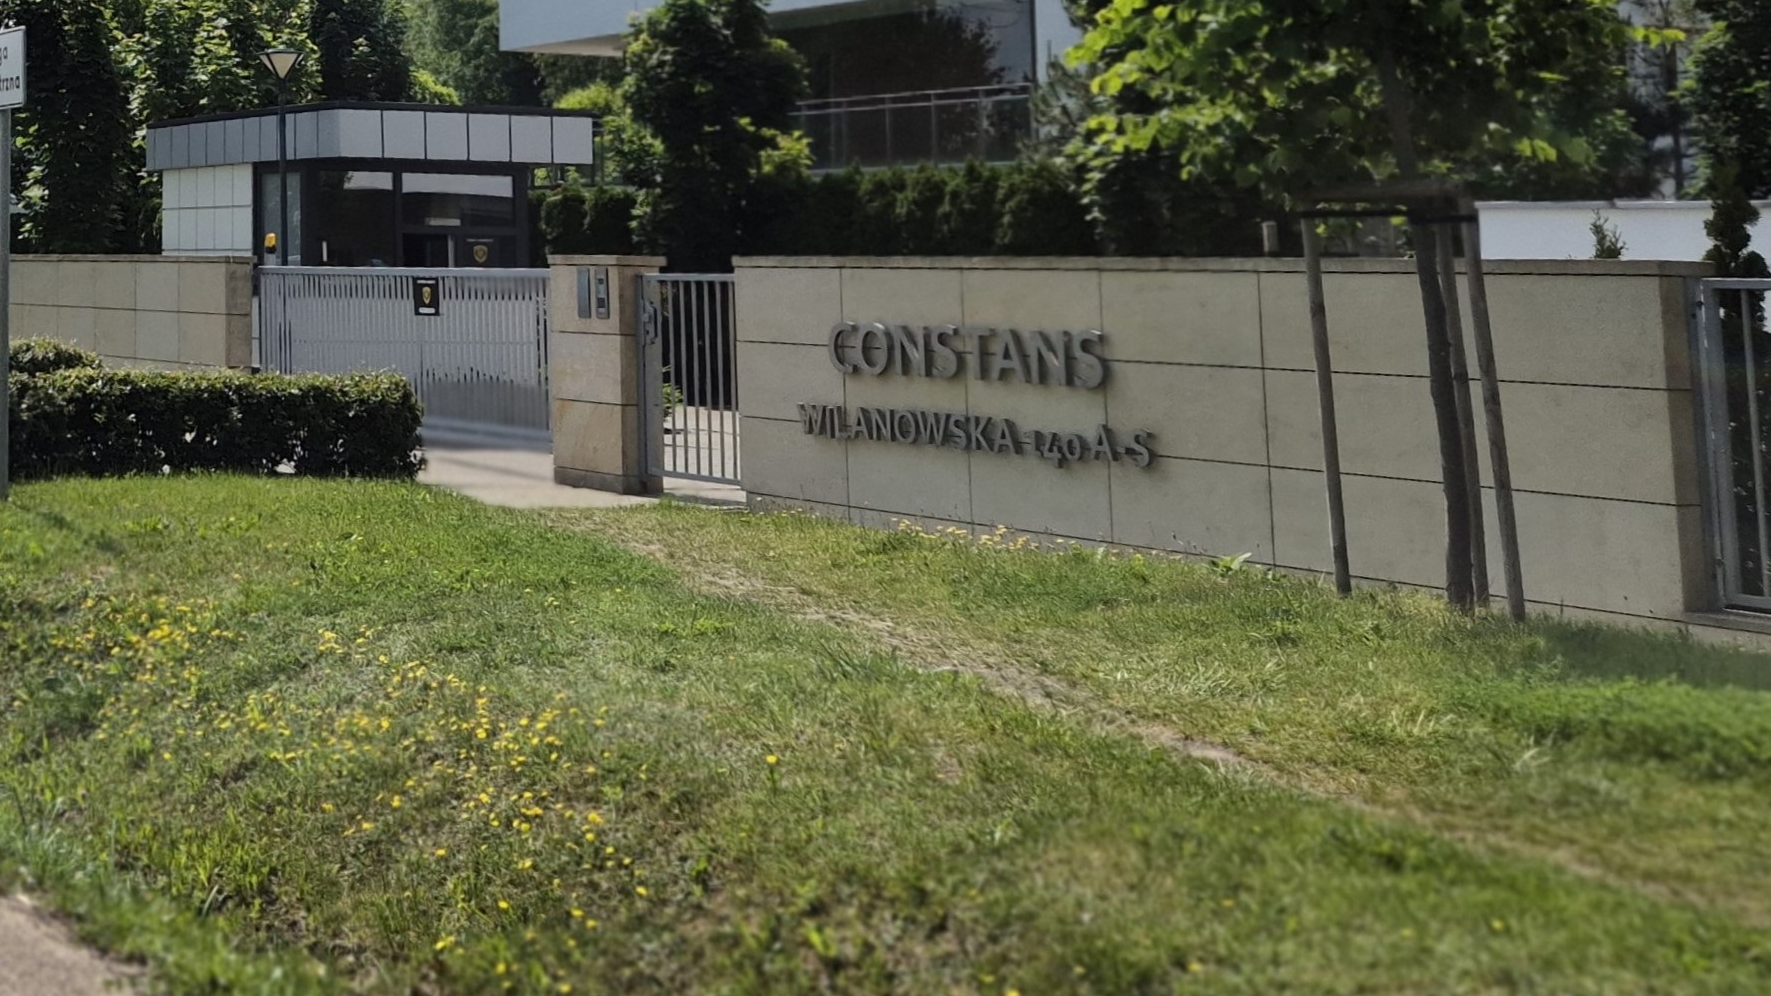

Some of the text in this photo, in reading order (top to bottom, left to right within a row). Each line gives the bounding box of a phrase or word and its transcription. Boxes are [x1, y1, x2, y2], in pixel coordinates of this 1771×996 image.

[829, 321, 1106, 390] CONSTANS
[797, 403, 1021, 454] WILANOWSKA
[1023, 430, 1084, 467] 140
